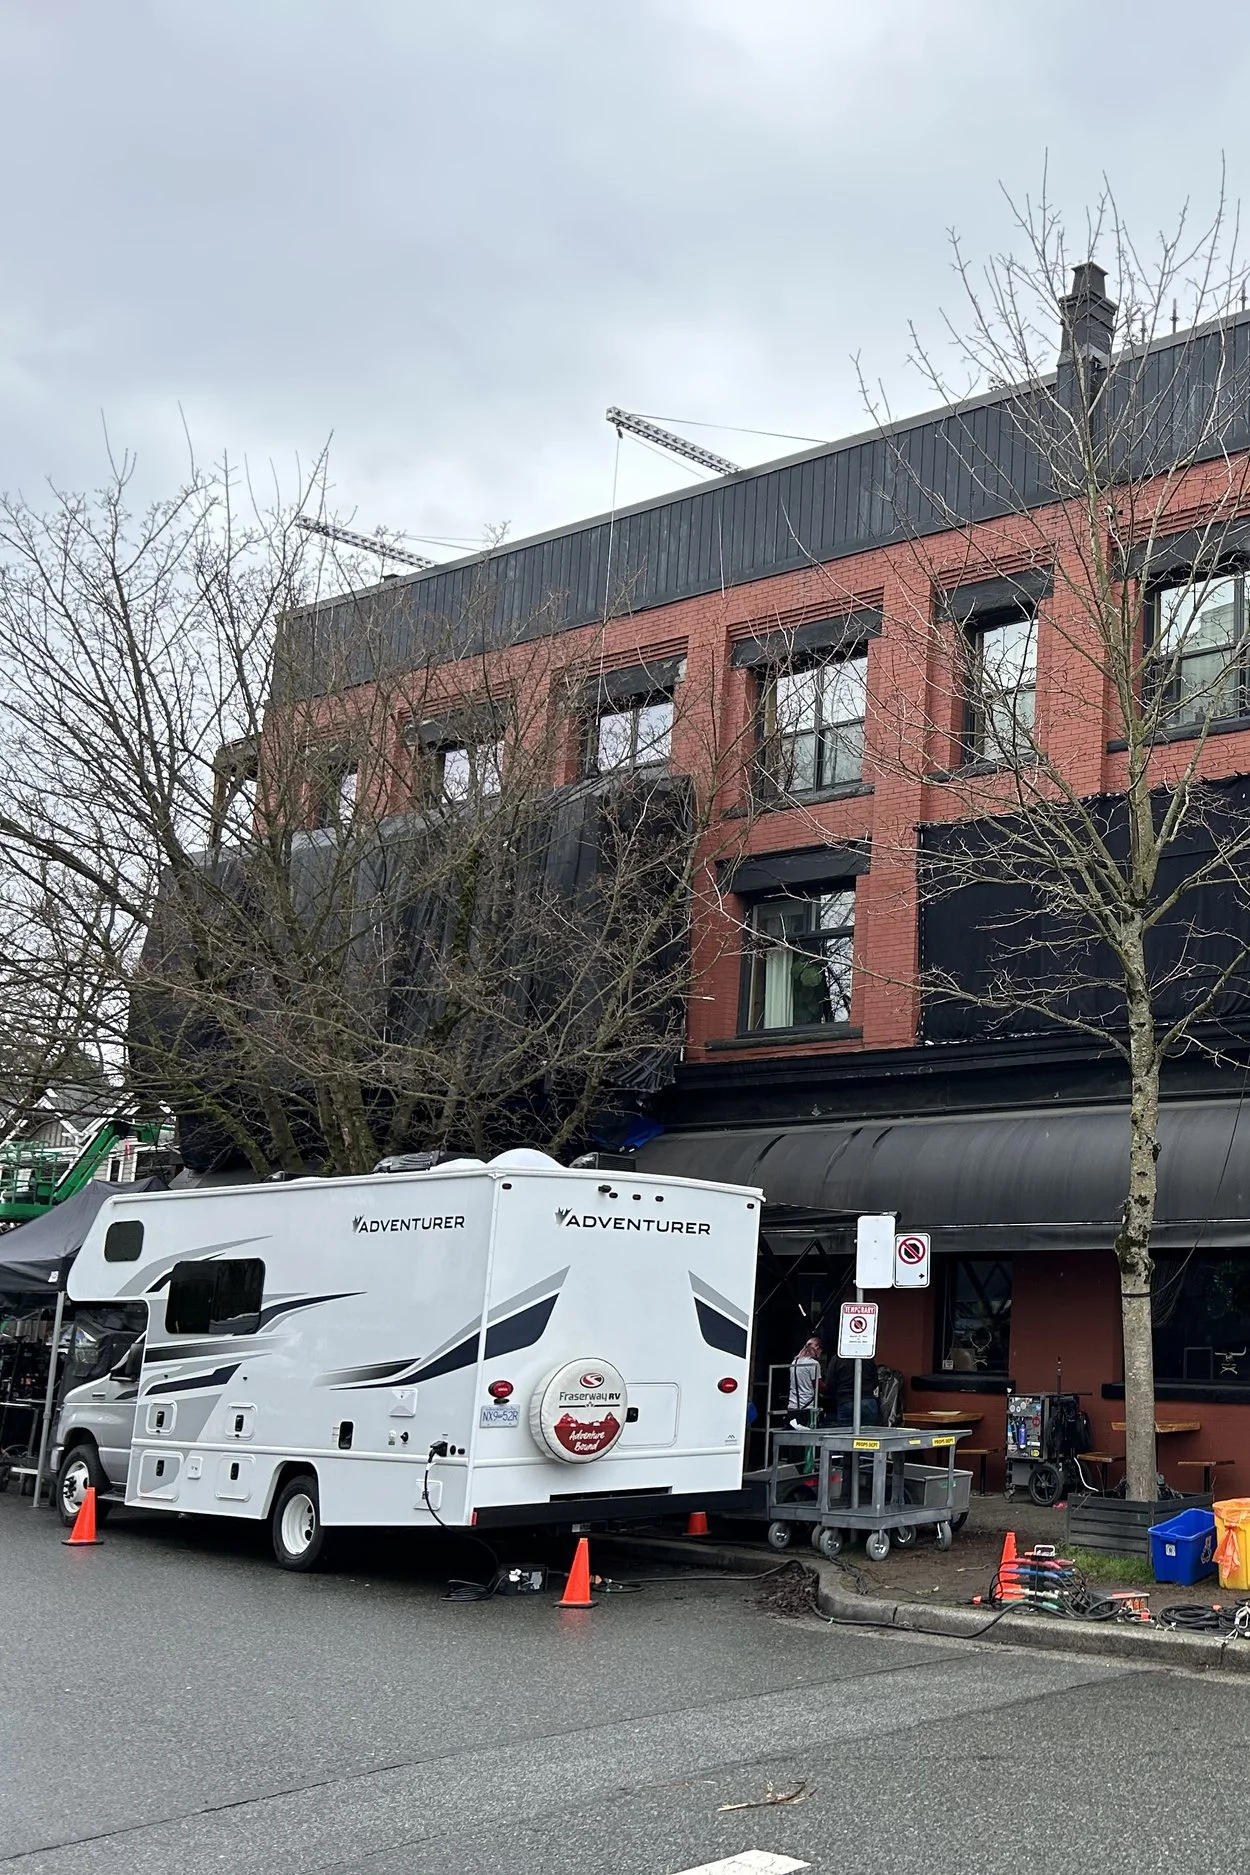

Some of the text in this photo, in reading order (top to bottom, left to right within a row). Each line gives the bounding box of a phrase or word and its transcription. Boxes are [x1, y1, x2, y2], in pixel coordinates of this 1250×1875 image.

[358, 1215, 466, 1234] ADVENTURER
[565, 1214, 712, 1236] ADVENTURER
[559, 1391, 621, 1402] Fraserway RV
[569, 1429, 606, 1441] Adventure
[574, 1441, 600, 1451] Bound
